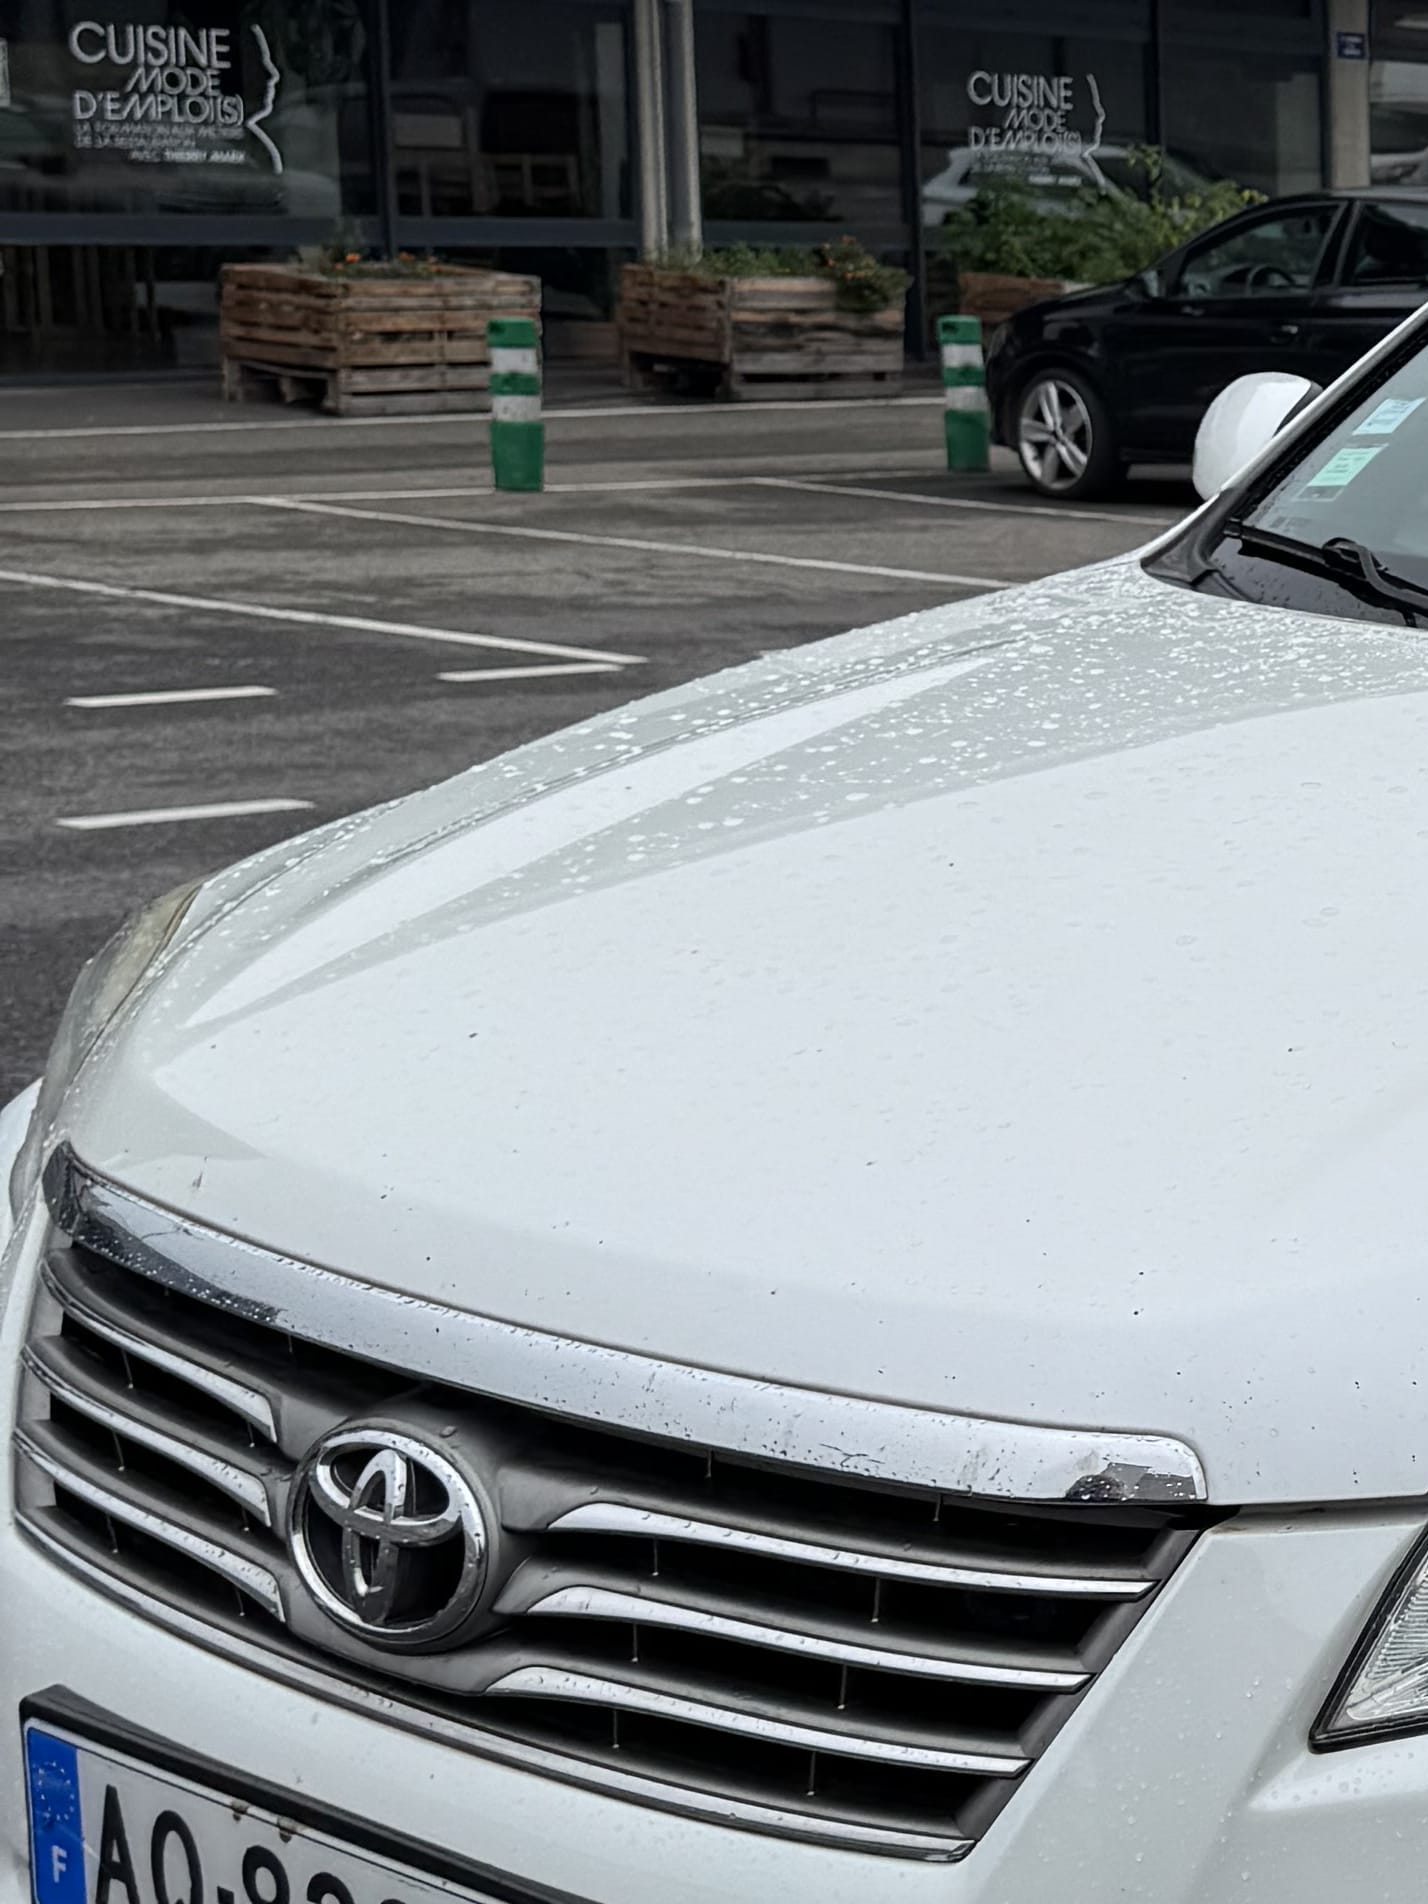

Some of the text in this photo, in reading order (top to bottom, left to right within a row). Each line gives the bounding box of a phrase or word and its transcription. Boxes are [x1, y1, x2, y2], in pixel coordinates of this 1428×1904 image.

[69, 20, 232, 70] CUISINE
[124, 66, 221, 97] MODE
[967, 70, 1073, 111] CUISINE
[1004, 107, 1067, 133] MODE
[49, 1844, 68, 1884] F
